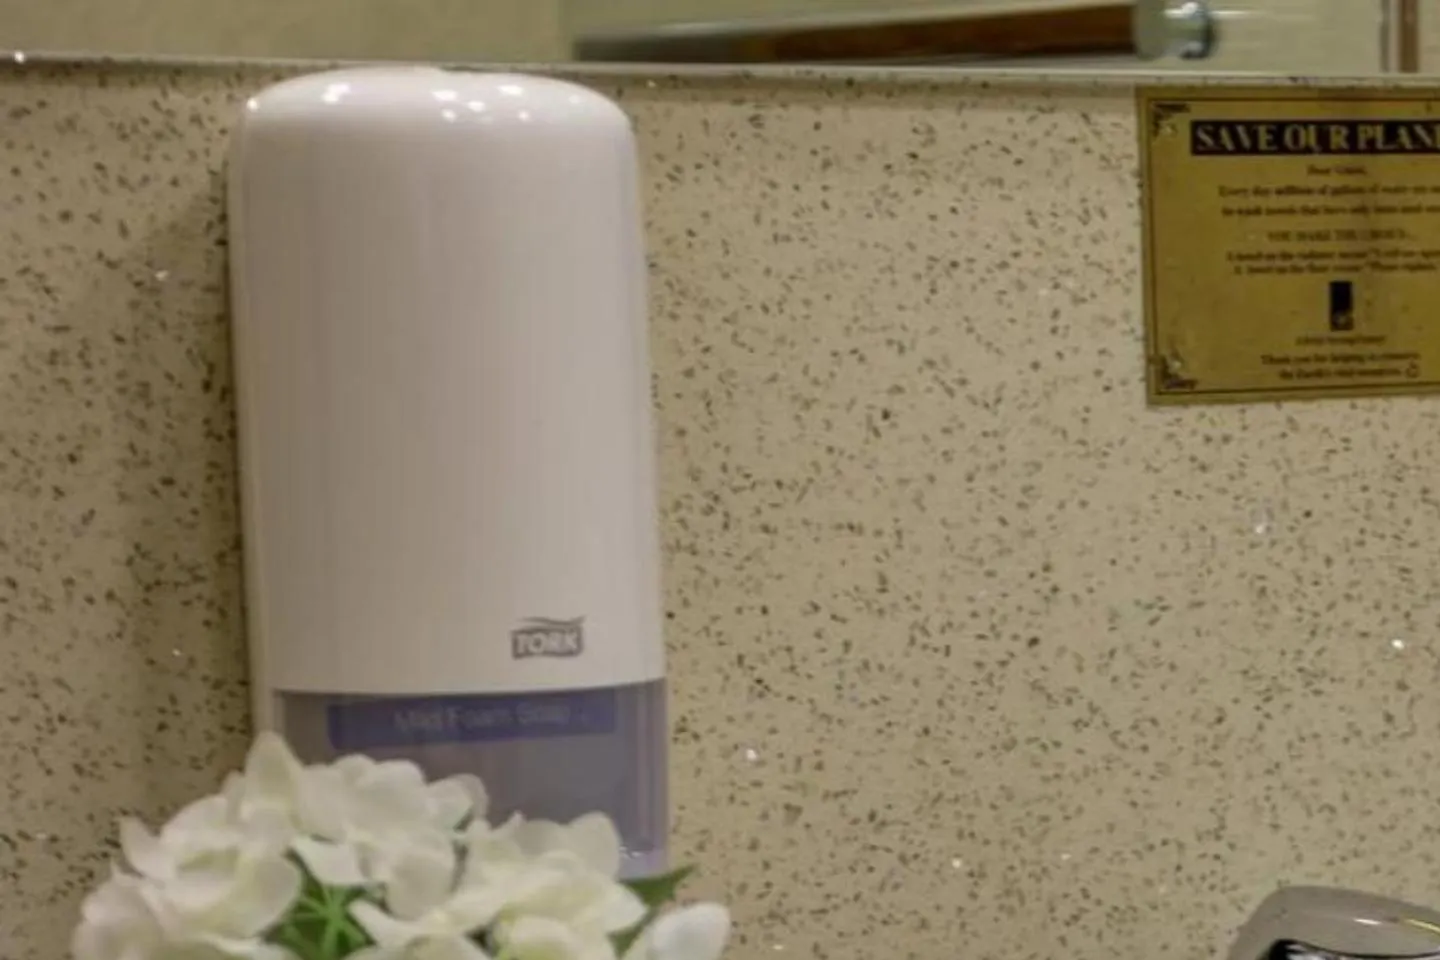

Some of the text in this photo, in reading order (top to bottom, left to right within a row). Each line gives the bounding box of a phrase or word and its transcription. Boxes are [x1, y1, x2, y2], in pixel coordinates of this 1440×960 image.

[1194, 124, 1278, 152] SAVE
[1282, 123, 1350, 154] OUR
[515, 630, 580, 655] TORK
[394, 704, 443, 731] Mild
